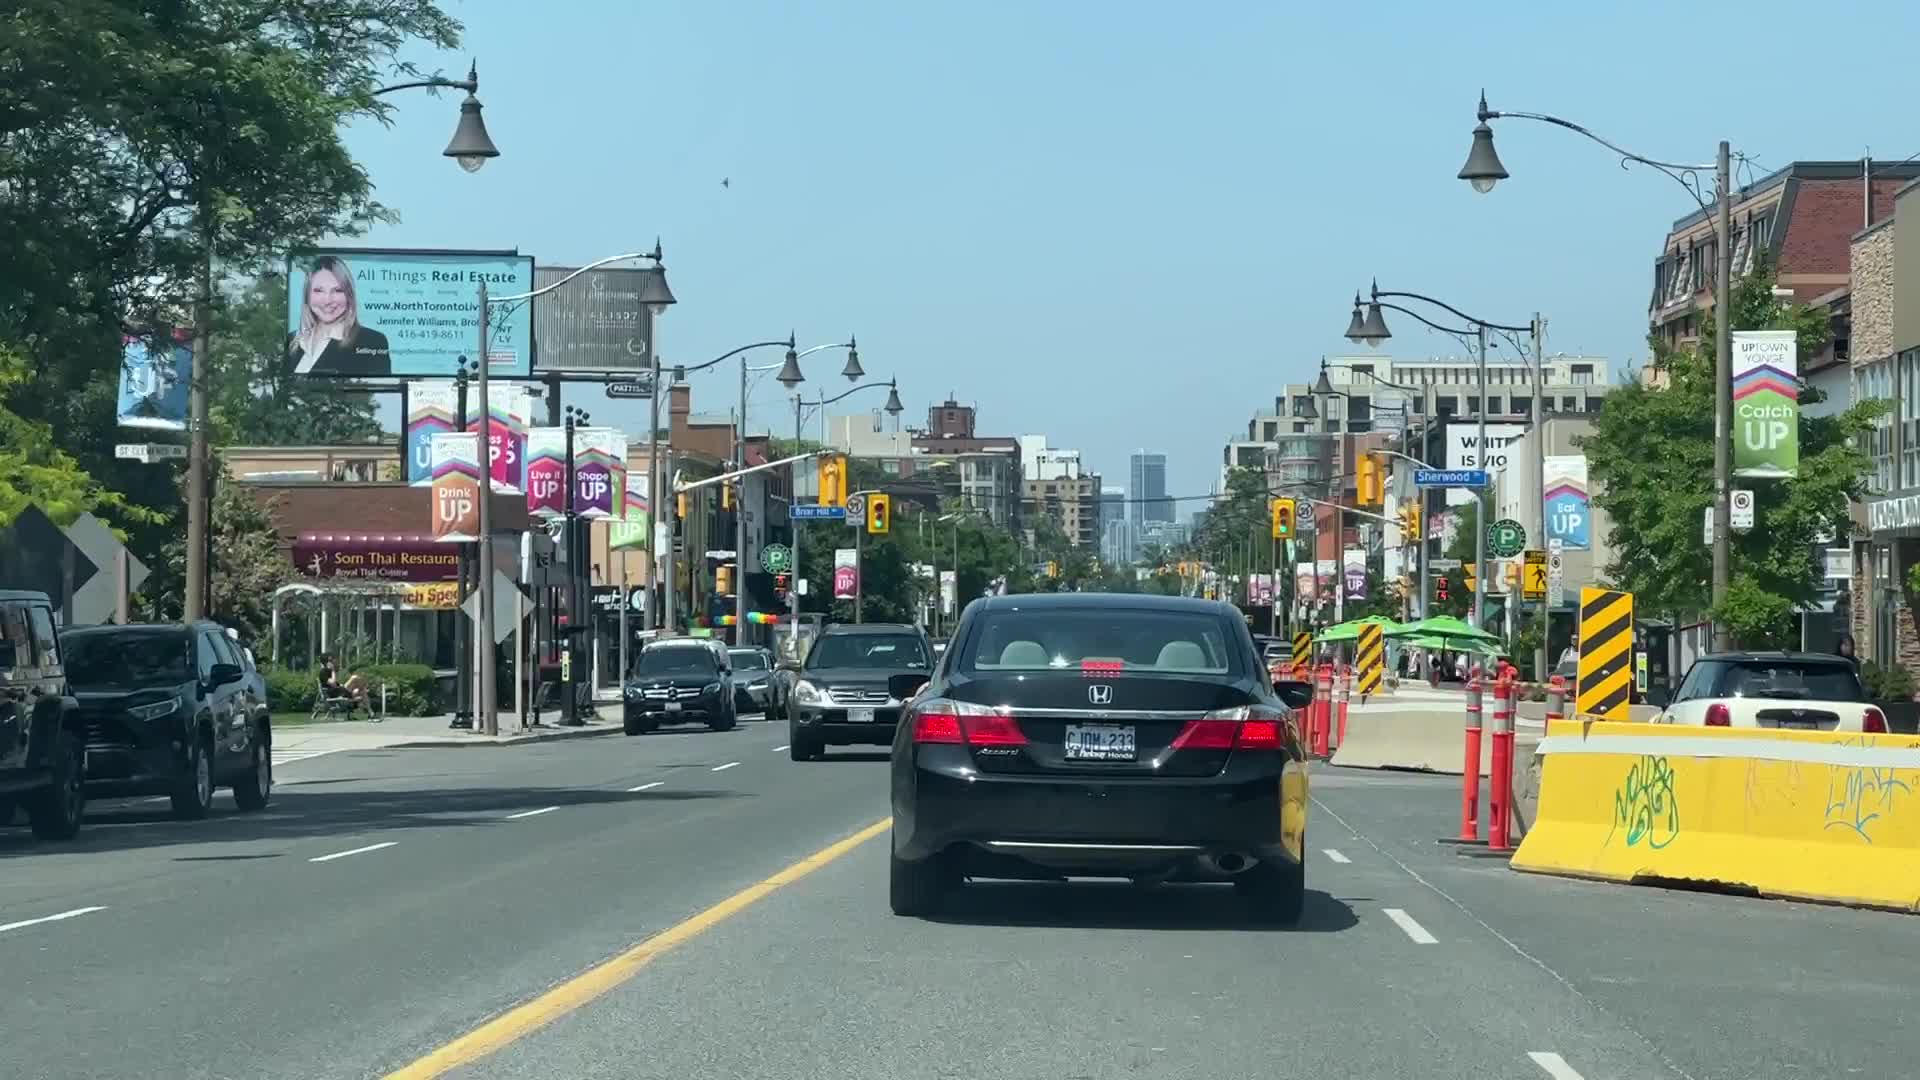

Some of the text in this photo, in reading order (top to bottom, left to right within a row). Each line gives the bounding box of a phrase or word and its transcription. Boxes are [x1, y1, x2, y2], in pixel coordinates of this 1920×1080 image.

[358, 269, 516, 284] All Things Real Estate
[376, 316, 415, 326] Jennifer
[1742, 343, 1788, 353] UPTOWN
[1739, 404, 1793, 418] Catch
[1745, 420, 1789, 451] UP
[531, 471, 551, 479] Live
[577, 472, 609, 481] Shape
[1418, 471, 1470, 482] Sherwood
[439, 487, 471, 498] Drink
[533, 480, 558, 499] UP
[581, 481, 607, 500] UP
[440, 500, 472, 522] UP
[795, 507, 814, 516] Briar
[816, 507, 830, 516] Hill
[1557, 503, 1576, 513] Eat
[1552, 513, 1582, 535] UP
[1501, 529, 1516, 545] P
[334, 552, 363, 565] Som
[368, 552, 396, 565] Thai
[1108, 751, 1134, 759] Honda
